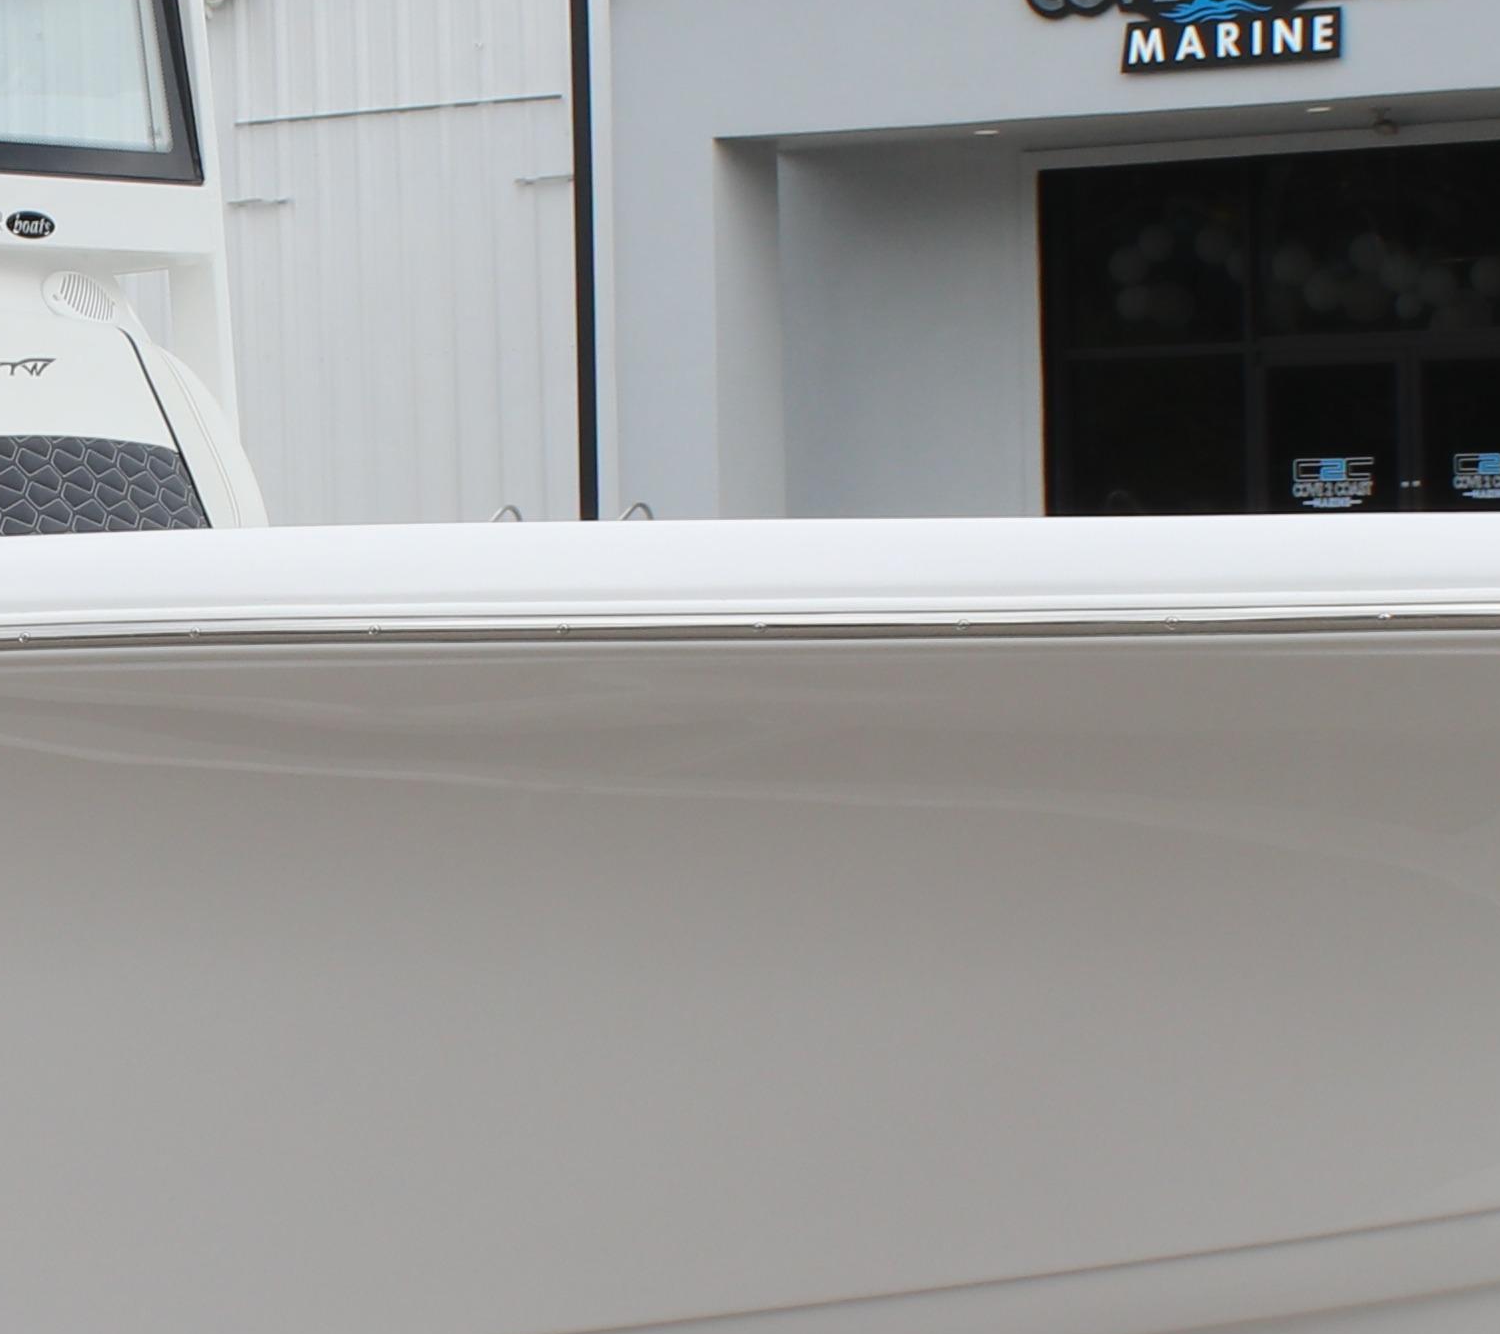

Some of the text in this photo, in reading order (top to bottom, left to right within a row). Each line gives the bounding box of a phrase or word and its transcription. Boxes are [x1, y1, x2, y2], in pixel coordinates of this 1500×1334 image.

[1128, 14, 1335, 65] MARINE
[11, 214, 53, 238] boats
[1292, 456, 1375, 482] C2C
